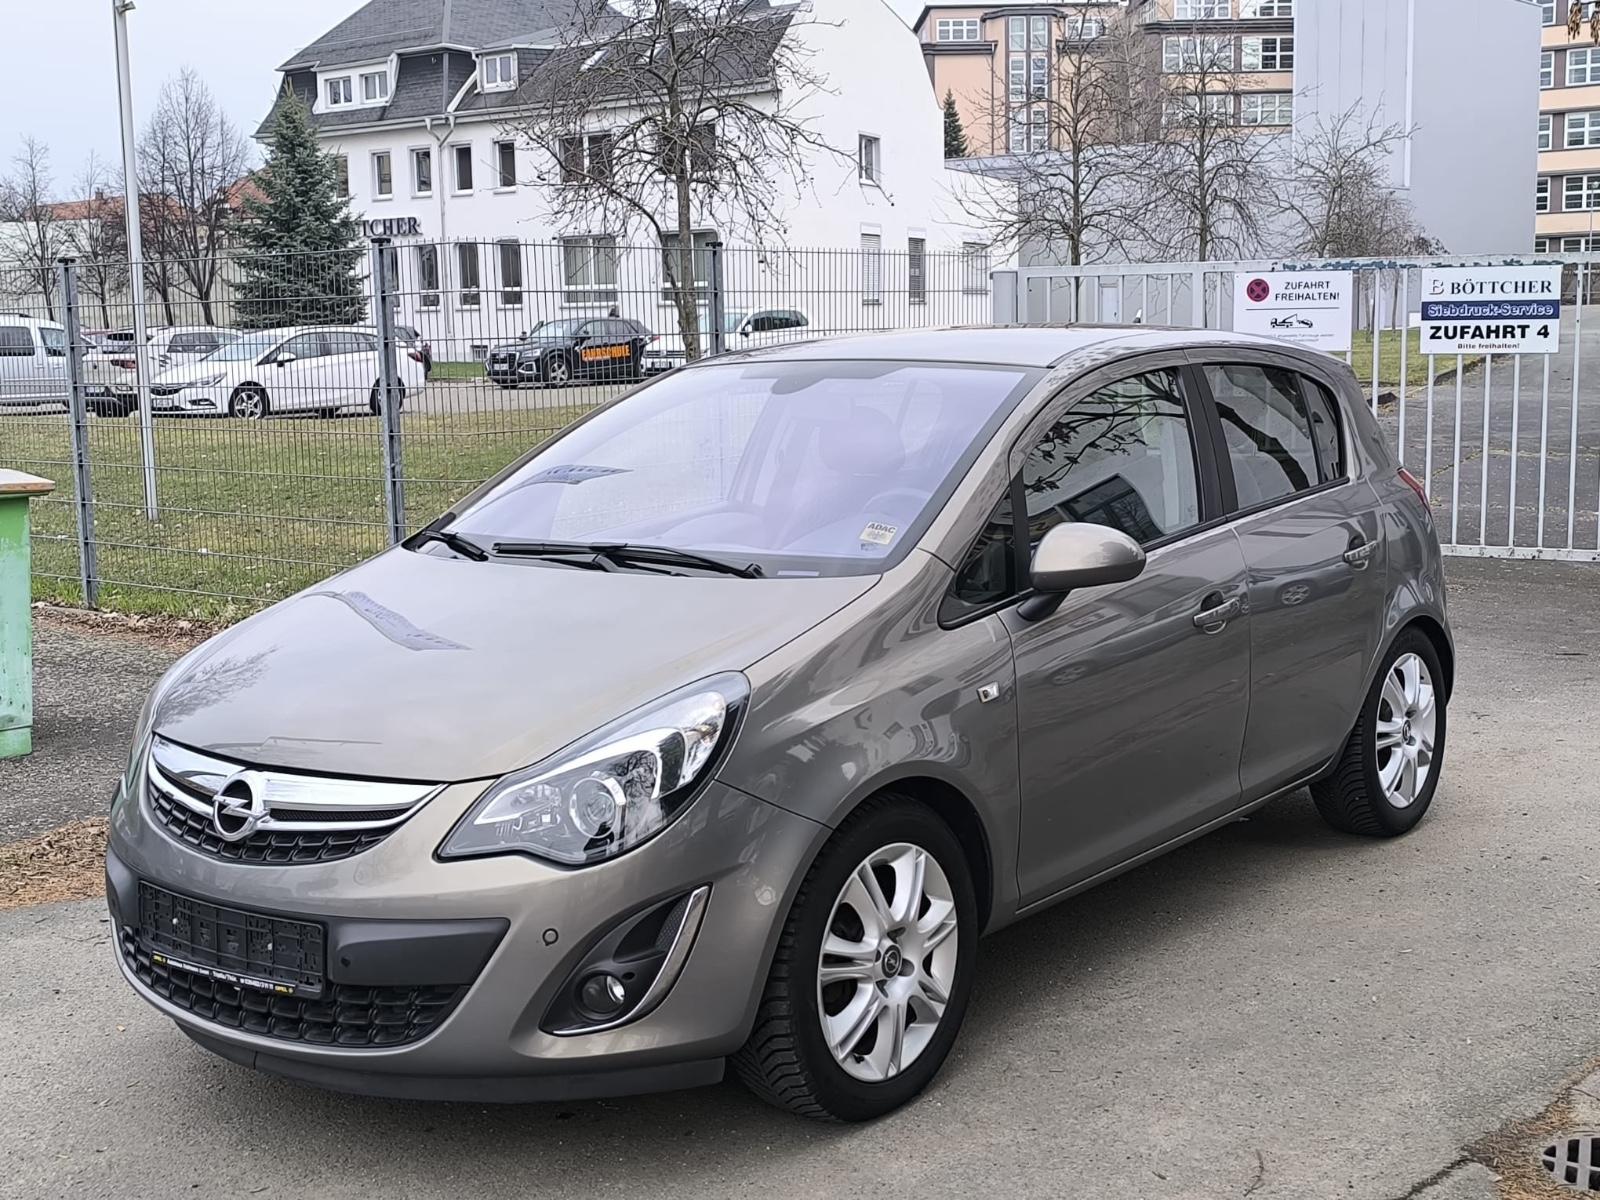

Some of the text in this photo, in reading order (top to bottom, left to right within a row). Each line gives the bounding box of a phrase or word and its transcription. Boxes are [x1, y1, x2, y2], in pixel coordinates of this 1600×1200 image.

[358, 217, 422, 237] TCHER
[1284, 281, 1330, 290] ZUFAHRT
[1450, 278, 1552, 295] BÖTTCHER
[1275, 292, 1340, 301] FREIHALTEN!
[1427, 303, 1554, 317] Siebdruck-Service
[1429, 324, 1549, 340] ZUFAHRT 4
[867, 523, 896, 533] ADAC
